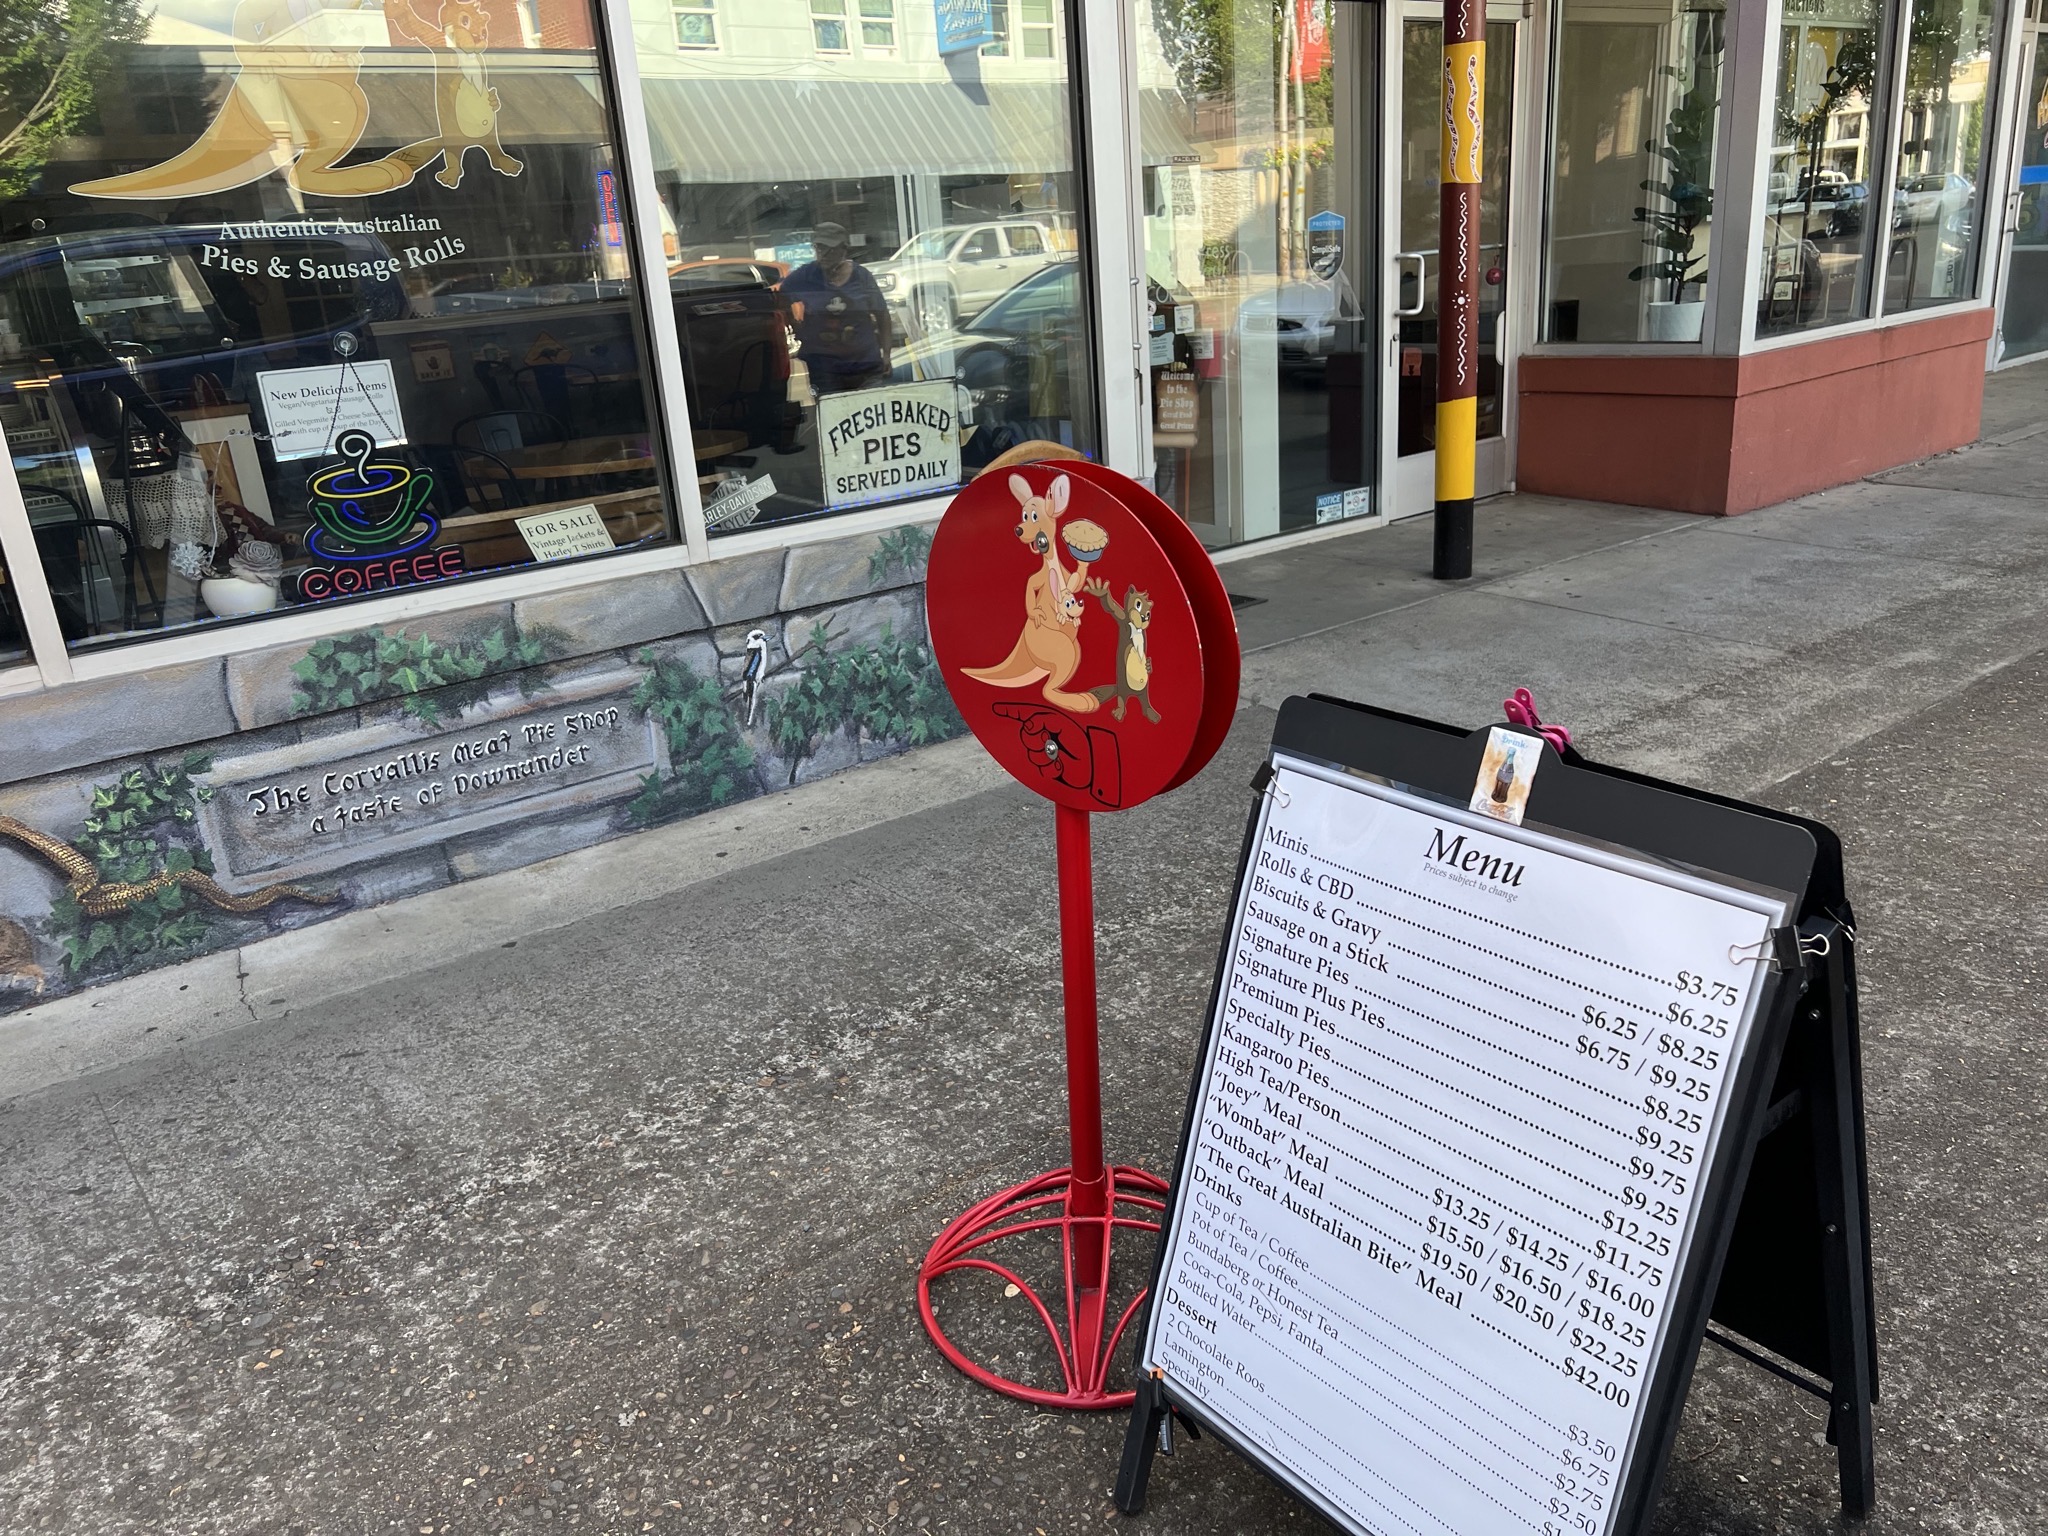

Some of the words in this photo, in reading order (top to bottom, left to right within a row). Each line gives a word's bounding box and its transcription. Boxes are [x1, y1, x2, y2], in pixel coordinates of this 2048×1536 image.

[1784, 0, 1825, 12] RACTIONS
[219, 218, 328, 240] Authentic
[335, 214, 441, 235] Australian
[601, 175, 619, 242] OPEN
[201, 243, 258, 275] Pies
[267, 256, 291, 279] &
[299, 255, 402, 281] Sausage
[404, 235, 466, 269] Rolls
[1312, 245, 1341, 255] SimpliSafe
[270, 391, 297, 401] New
[300, 385, 354, 398] Delicious
[356, 382, 387, 392] Iems
[1161, 371, 1195, 381] Welcome
[1175, 397, 1194, 409] Shop
[1176, 383, 1188, 394] the
[291, 427, 307, 435] with
[368, 419, 382, 427] Day
[337, 413, 361, 421] Cheese
[828, 402, 887, 457] FRESH
[891, 400, 950, 432] BAKED
[863, 432, 921, 465] PIES
[703, 481, 771, 524] ARLEY-DAVIDSON
[711, 480, 744, 501] MOTOR
[837, 468, 901, 494] SERVED
[905, 460, 948, 482] DAILY
[1318, 494, 1341, 506] NOTICE
[526, 522, 558, 538] FOR
[559, 514, 596, 531] SALE
[533, 537, 566, 550] Vintage
[566, 530, 596, 544] Jackets
[596, 528, 605, 536] &
[722, 506, 756, 529] CYCLES
[304, 550, 463, 598] COFFEE
[543, 547, 573, 559] Harley
[572, 544, 580, 553] T
[580, 540, 606, 551] Shirts
[247, 784, 311, 817] The
[323, 751, 441, 796] Corvallis
[452, 729, 512, 764] Meat
[521, 722, 556, 744] Pie
[564, 706, 619, 736] Shop
[311, 815, 327, 834] a
[334, 794, 404, 830] taste
[417, 782, 443, 806] of
[451, 744, 591, 795] Downunder
[1423, 827, 1526, 888] Menu
[1423, 862, 1447, 879] Prices
[1448, 871, 1478, 889] subject
[1478, 881, 1487, 892] to
[1488, 884, 1519, 903] change
[1265, 826, 1309, 856] Minis
[1674, 970, 1739, 1007] $3.75
[1253, 875, 1310, 912] Biscuits
[1312, 900, 1327, 920] &
[1331, 908, 1382, 945] Gravy
[1581, 1004, 1638, 1041] $6.25
[1657, 1032, 1720, 1071] $8.25
[1259, 851, 1297, 879] Rolls
[1300, 867, 1314, 886] &
[1317, 874, 1354, 900] CBD
[1665, 1001, 1729, 1039] $6.25
[1246, 900, 1306, 940] Sausage
[1309, 930, 1329, 949] on
[1332, 940, 1342, 954] a
[1345, 942, 1390, 974] Stick
[1575, 1034, 1631, 1071] $6.75
[1649, 1064, 1711, 1102] $9.25
[1237, 949, 1308, 995] Signature
[1310, 981, 1346, 1012] Plus
[1350, 999, 1386, 1030] Pies
[1635, 1125, 1695, 1165] $9.25
[1242, 925, 1312, 969] Signature
[1315, 956, 1349, 985] Pies
[1642, 1094, 1703, 1134] $8.25
[1227, 997, 1295, 1045] Specialty
[1297, 1031, 1331, 1061] Pies
[1620, 1185, 1679, 1226] $9.25
[1232, 972, 1299, 1018] Premium
[1302, 1005, 1336, 1035] Pies
[1628, 1155, 1687, 1195] $9.75
[1217, 1045, 1254, 1077] High
[1259, 1065, 1341, 1123] Tea/Person
[1593, 1239, 1663, 1288] $11.75
[1222, 1021, 1293, 1070] Kangaroo
[1296, 1058, 1330, 1088] Pies
[1601, 1209, 1672, 1257] $12.25
[1193, 1164, 1243, 1208] Drinks
[1214, 1070, 1261, 1106] "Joey"
[1263, 1096, 1303, 1131] Meal
[1432, 1187, 1491, 1231] $13.25
[1505, 1226, 1570, 1272] $14.25
[1585, 1268, 1655, 1318] $16.00
[1204, 1117, 1282, 1171] "Outback"
[1283, 1163, 1324, 1200] Meal
[1420, 1241, 1479, 1287] $19.50
[1492, 1282, 1555, 1331] $20.50
[1569, 1327, 1639, 1378] $22.25
[1209, 1094, 1286, 1145] "Wombat"
[1288, 1137, 1329, 1174] Meal
[1426, 1214, 1485, 1259] $15.50
[1499, 1254, 1562, 1302] $16.50
[1577, 1298, 1647, 1348] $18.25
[1177, 1270, 1217, 1307] Bottled
[1220, 1299, 1256, 1334] Water
[1199, 1141, 1233, 1174] "The
[1237, 1165, 1278, 1201] Great
[1279, 1191, 1362, 1252] Australian
[1366, 1239, 1413, 1274] Bite"
[1415, 1268, 1463, 1310] Meal
[1561, 1356, 1630, 1409] $42.00
[1165, 1286, 1218, 1335] Dessert
[1195, 1191, 1221, 1219] Cup
[1222, 1212, 1237, 1226] of
[1238, 1218, 1259, 1241] Tea
[1268, 1237, 1310, 1273] Coffee
[1566, 1424, 1616, 1463] $3.50
[1160, 1351, 1210, 1399] Specialty
[1164, 1332, 1225, 1388] Lamington
[1167, 1313, 1176, 1327] 2
[1177, 1320, 1234, 1370] Chocolate
[1235, 1361, 1266, 1393] Roos
[1187, 1230, 1251, 1286] Bundaberg
[1251, 1277, 1266, 1291] or
[1267, 1282, 1315, 1324] Honest
[1317, 1313, 1339, 1340] Tea
[1554, 1472, 1604, 1511] $2.75
[1191, 1210, 1211, 1234] Pot
[1213, 1229, 1227, 1243] of
[1228, 1233, 1249, 1258] Tea
[1258, 1254, 1298, 1289] Coffee
[1560, 1448, 1610, 1487] $6.75
[1248, 1295, 1285, 1331] Pepsi,
[1287, 1320, 1325, 1358] Fanta
[1547, 1496, 1597, 1536] $2.50
